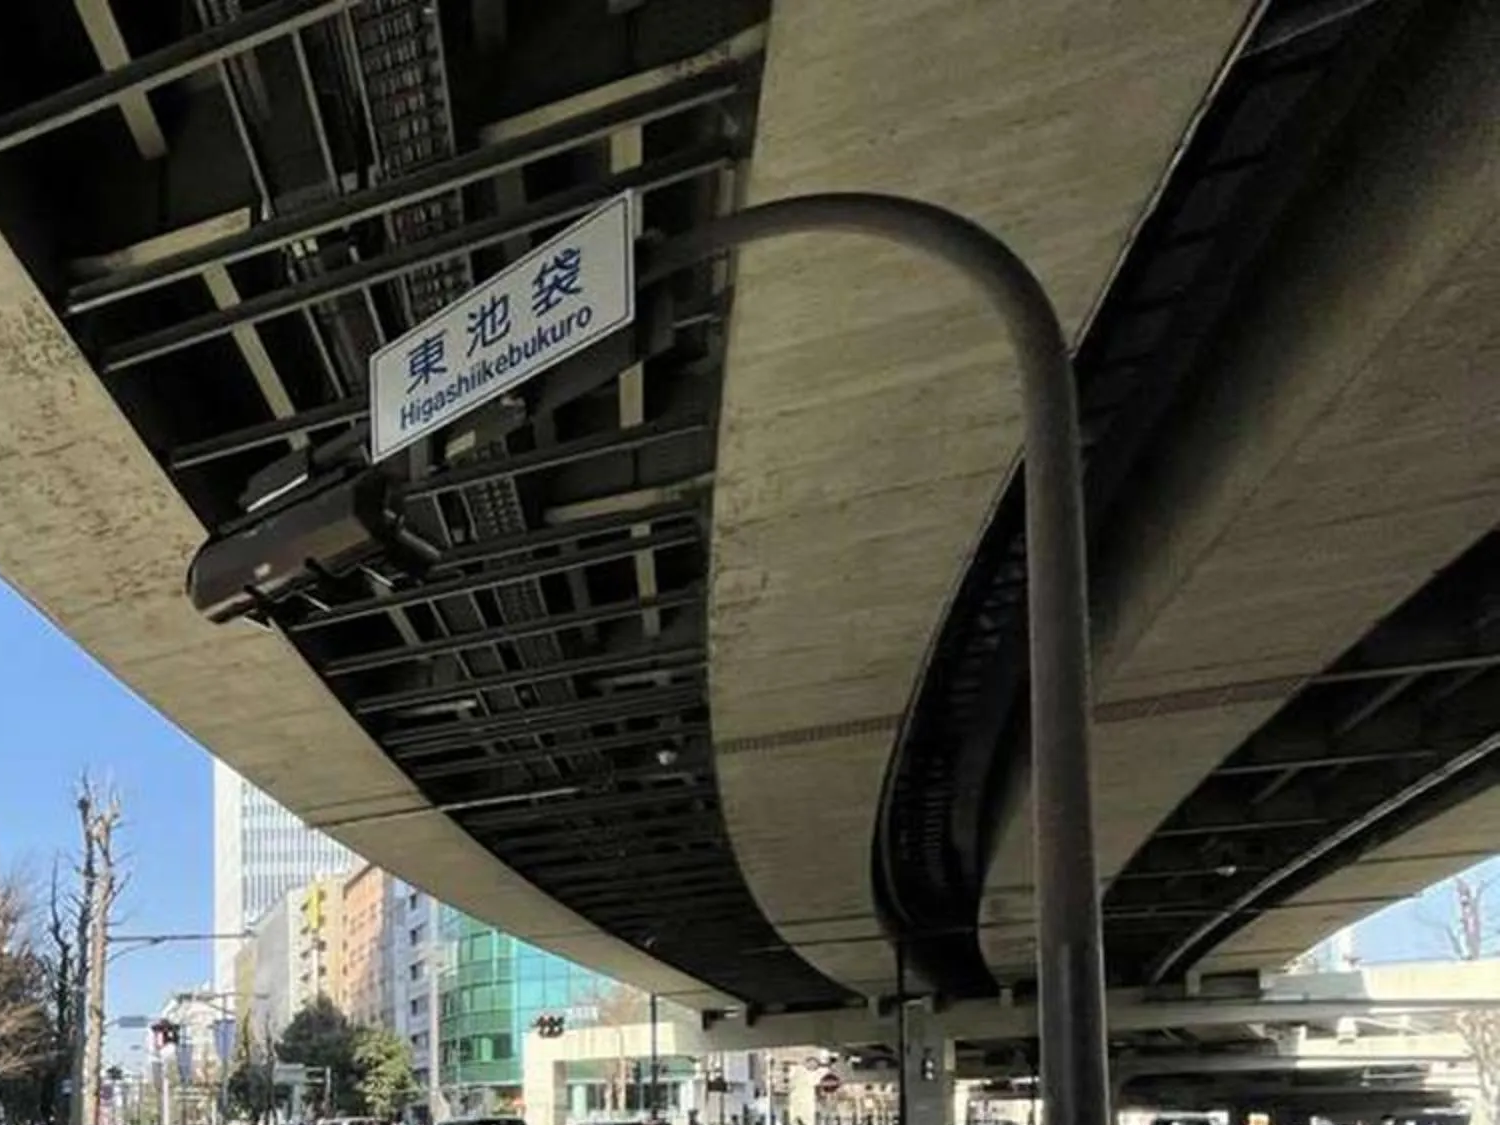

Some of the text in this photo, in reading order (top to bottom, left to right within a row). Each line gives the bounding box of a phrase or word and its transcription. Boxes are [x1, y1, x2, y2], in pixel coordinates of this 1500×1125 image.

[399, 305, 593, 430] Higashiikebukuro
[405, 247, 583, 394] 東池袋
